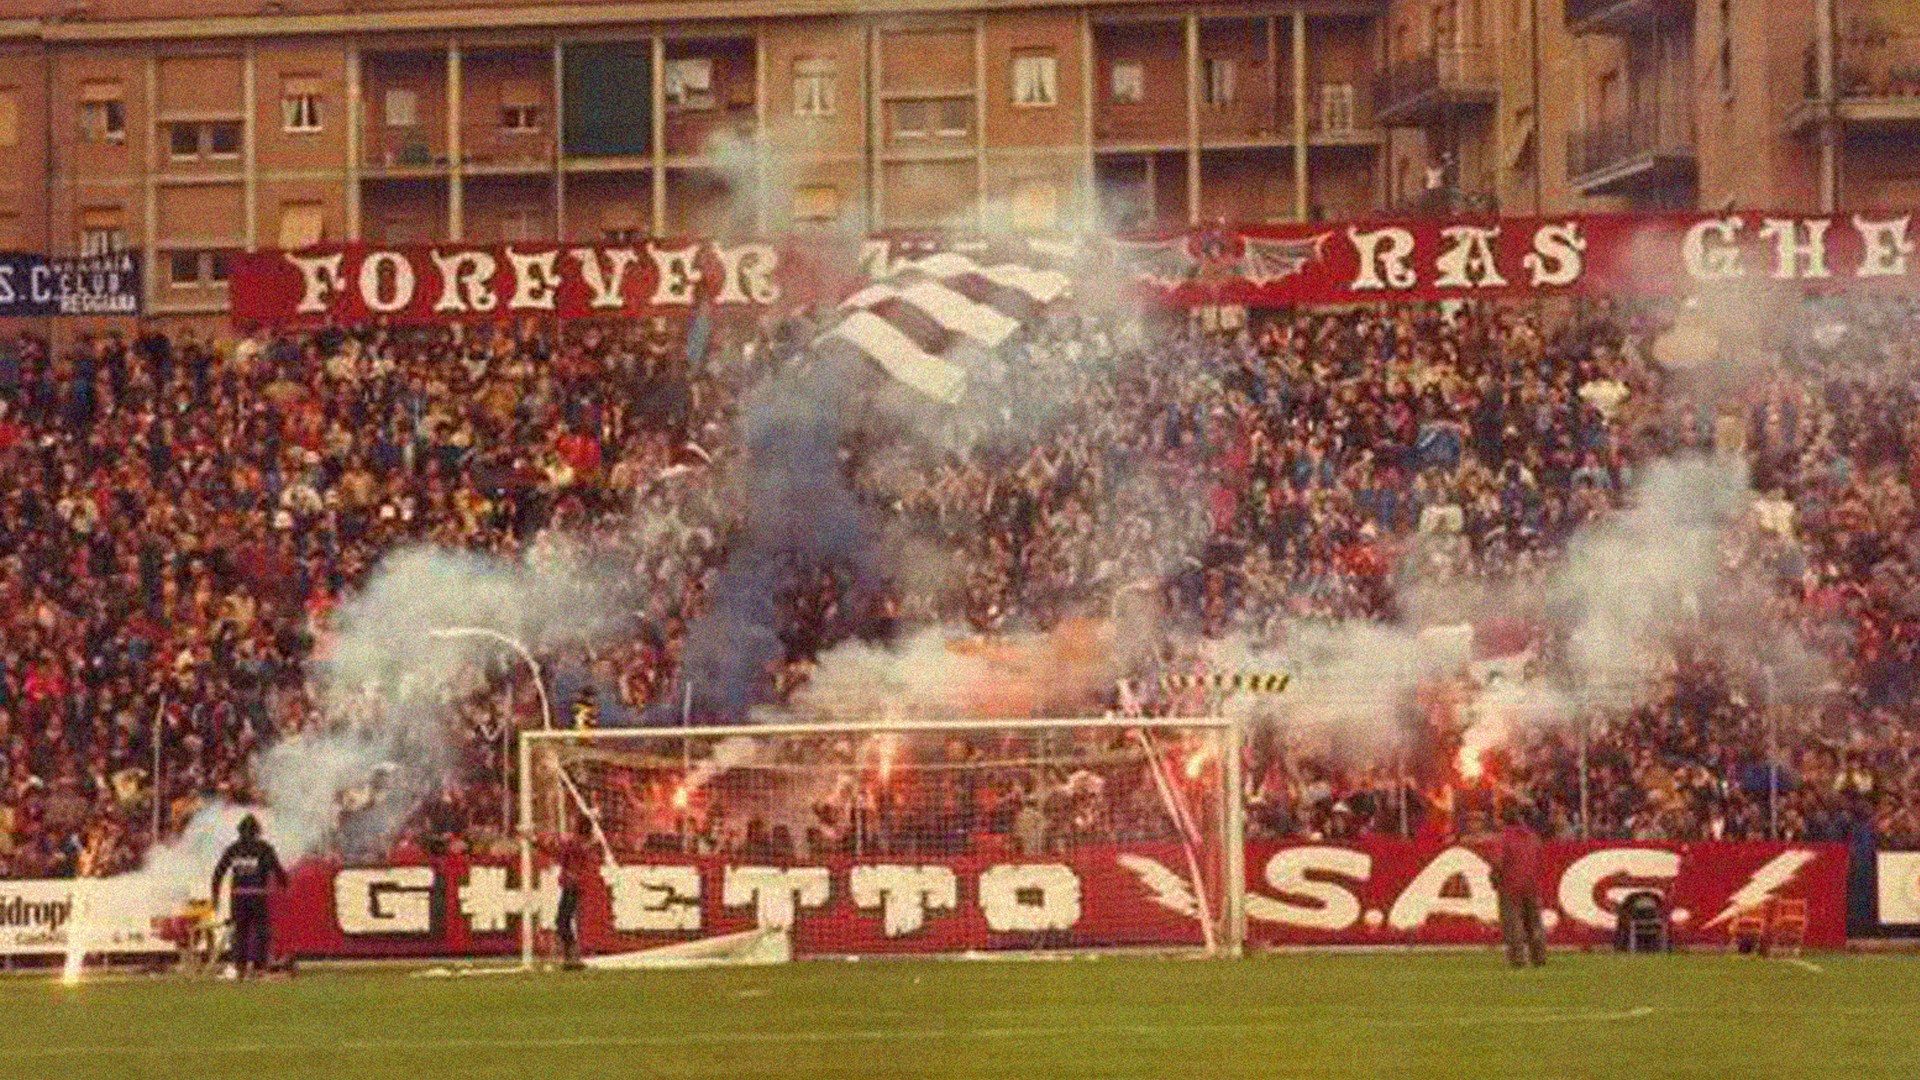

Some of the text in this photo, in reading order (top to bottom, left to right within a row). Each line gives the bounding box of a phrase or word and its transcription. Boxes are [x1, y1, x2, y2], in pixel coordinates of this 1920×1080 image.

[285, 241, 779, 314] FOREVER
[1347, 221, 1587, 290] RAS
[1682, 214, 1915, 280] GHE
[334, 862, 1082, 938] GHETTO
